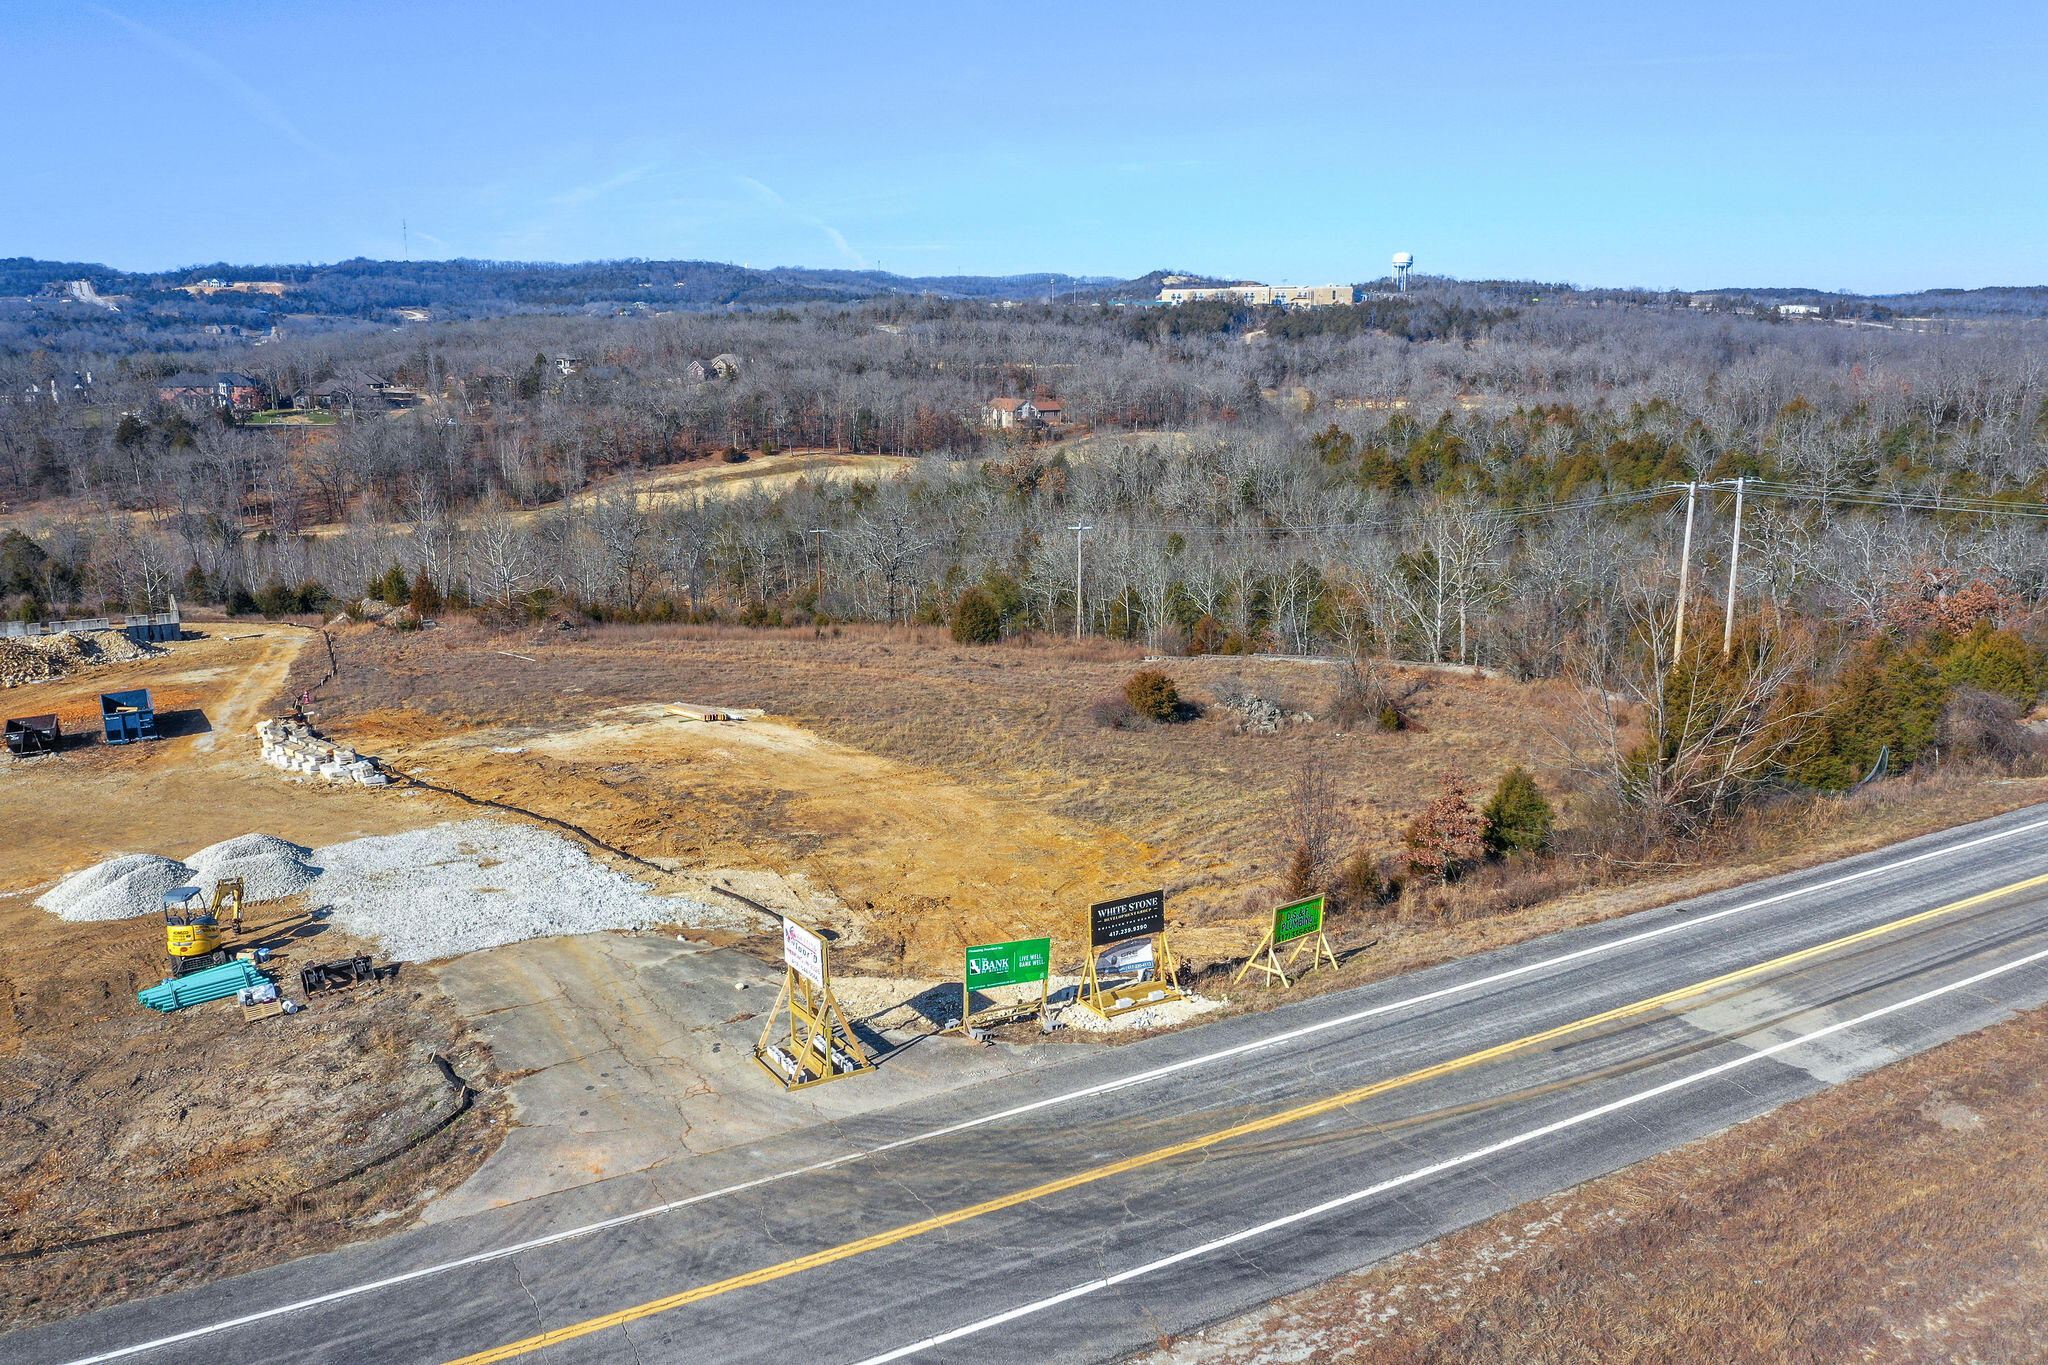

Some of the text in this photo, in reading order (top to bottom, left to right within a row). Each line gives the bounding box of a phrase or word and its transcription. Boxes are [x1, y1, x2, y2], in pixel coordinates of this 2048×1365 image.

[1097, 897, 1158, 918] WHITE STONE
[1281, 914, 1314, 933] PLUMBING
[982, 958, 1009, 971] BANK
